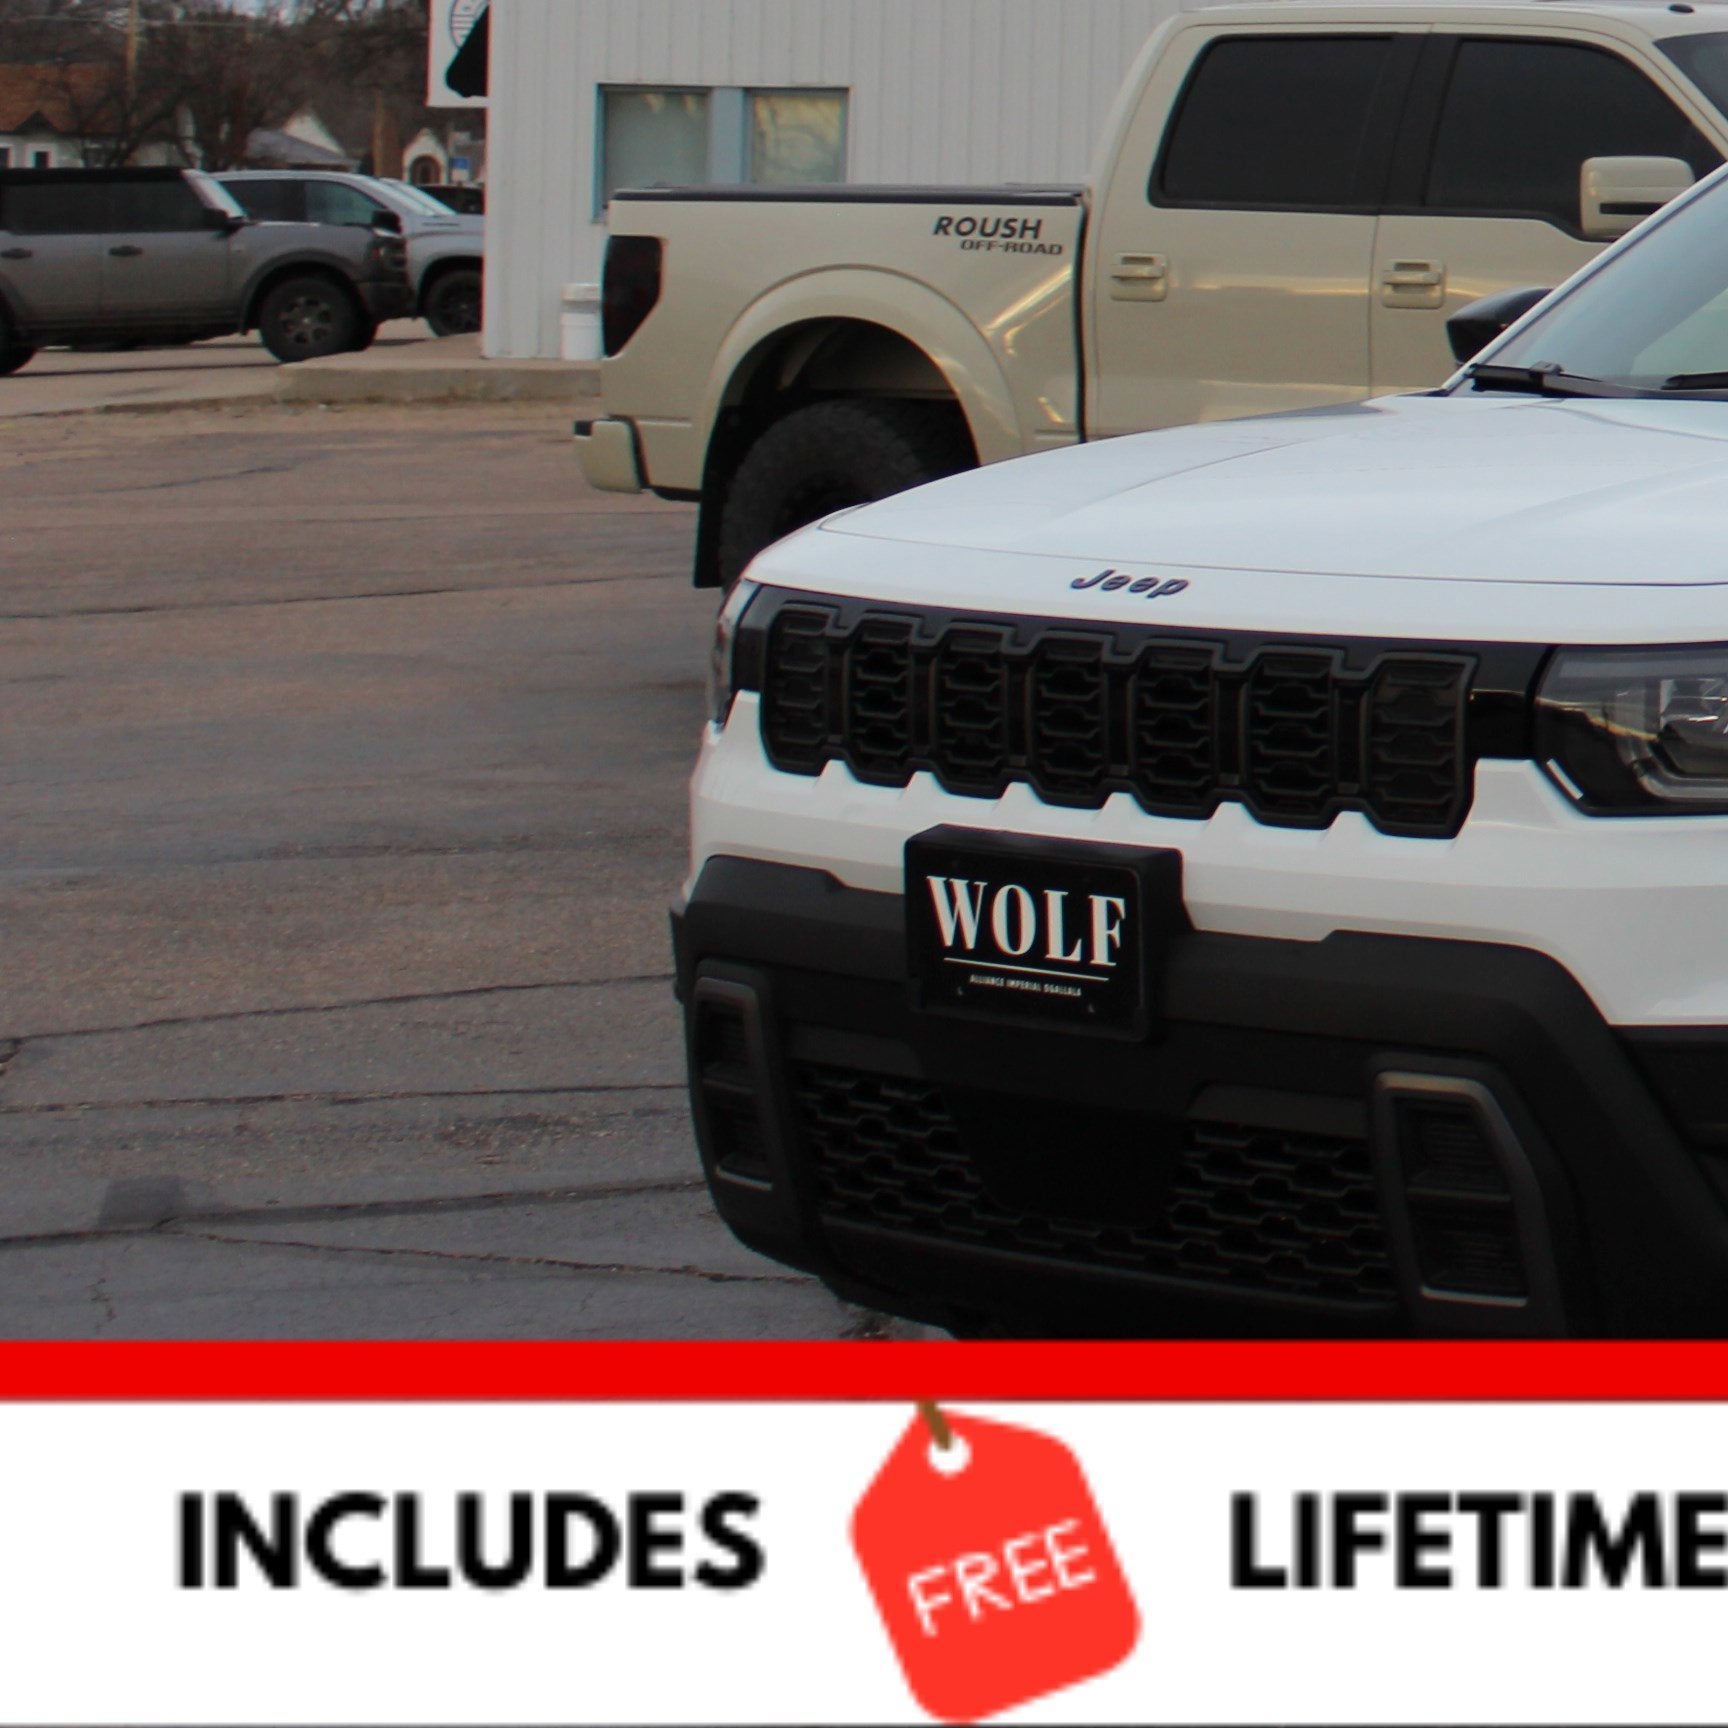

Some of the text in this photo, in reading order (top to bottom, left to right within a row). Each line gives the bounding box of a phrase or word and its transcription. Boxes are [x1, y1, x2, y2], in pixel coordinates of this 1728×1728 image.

[932, 215, 1042, 241] ROUSH
[960, 238, 1064, 256] OFF-ROAD
[1070, 568, 1190, 599] Jeep
[926, 875, 1126, 967] WOLF
